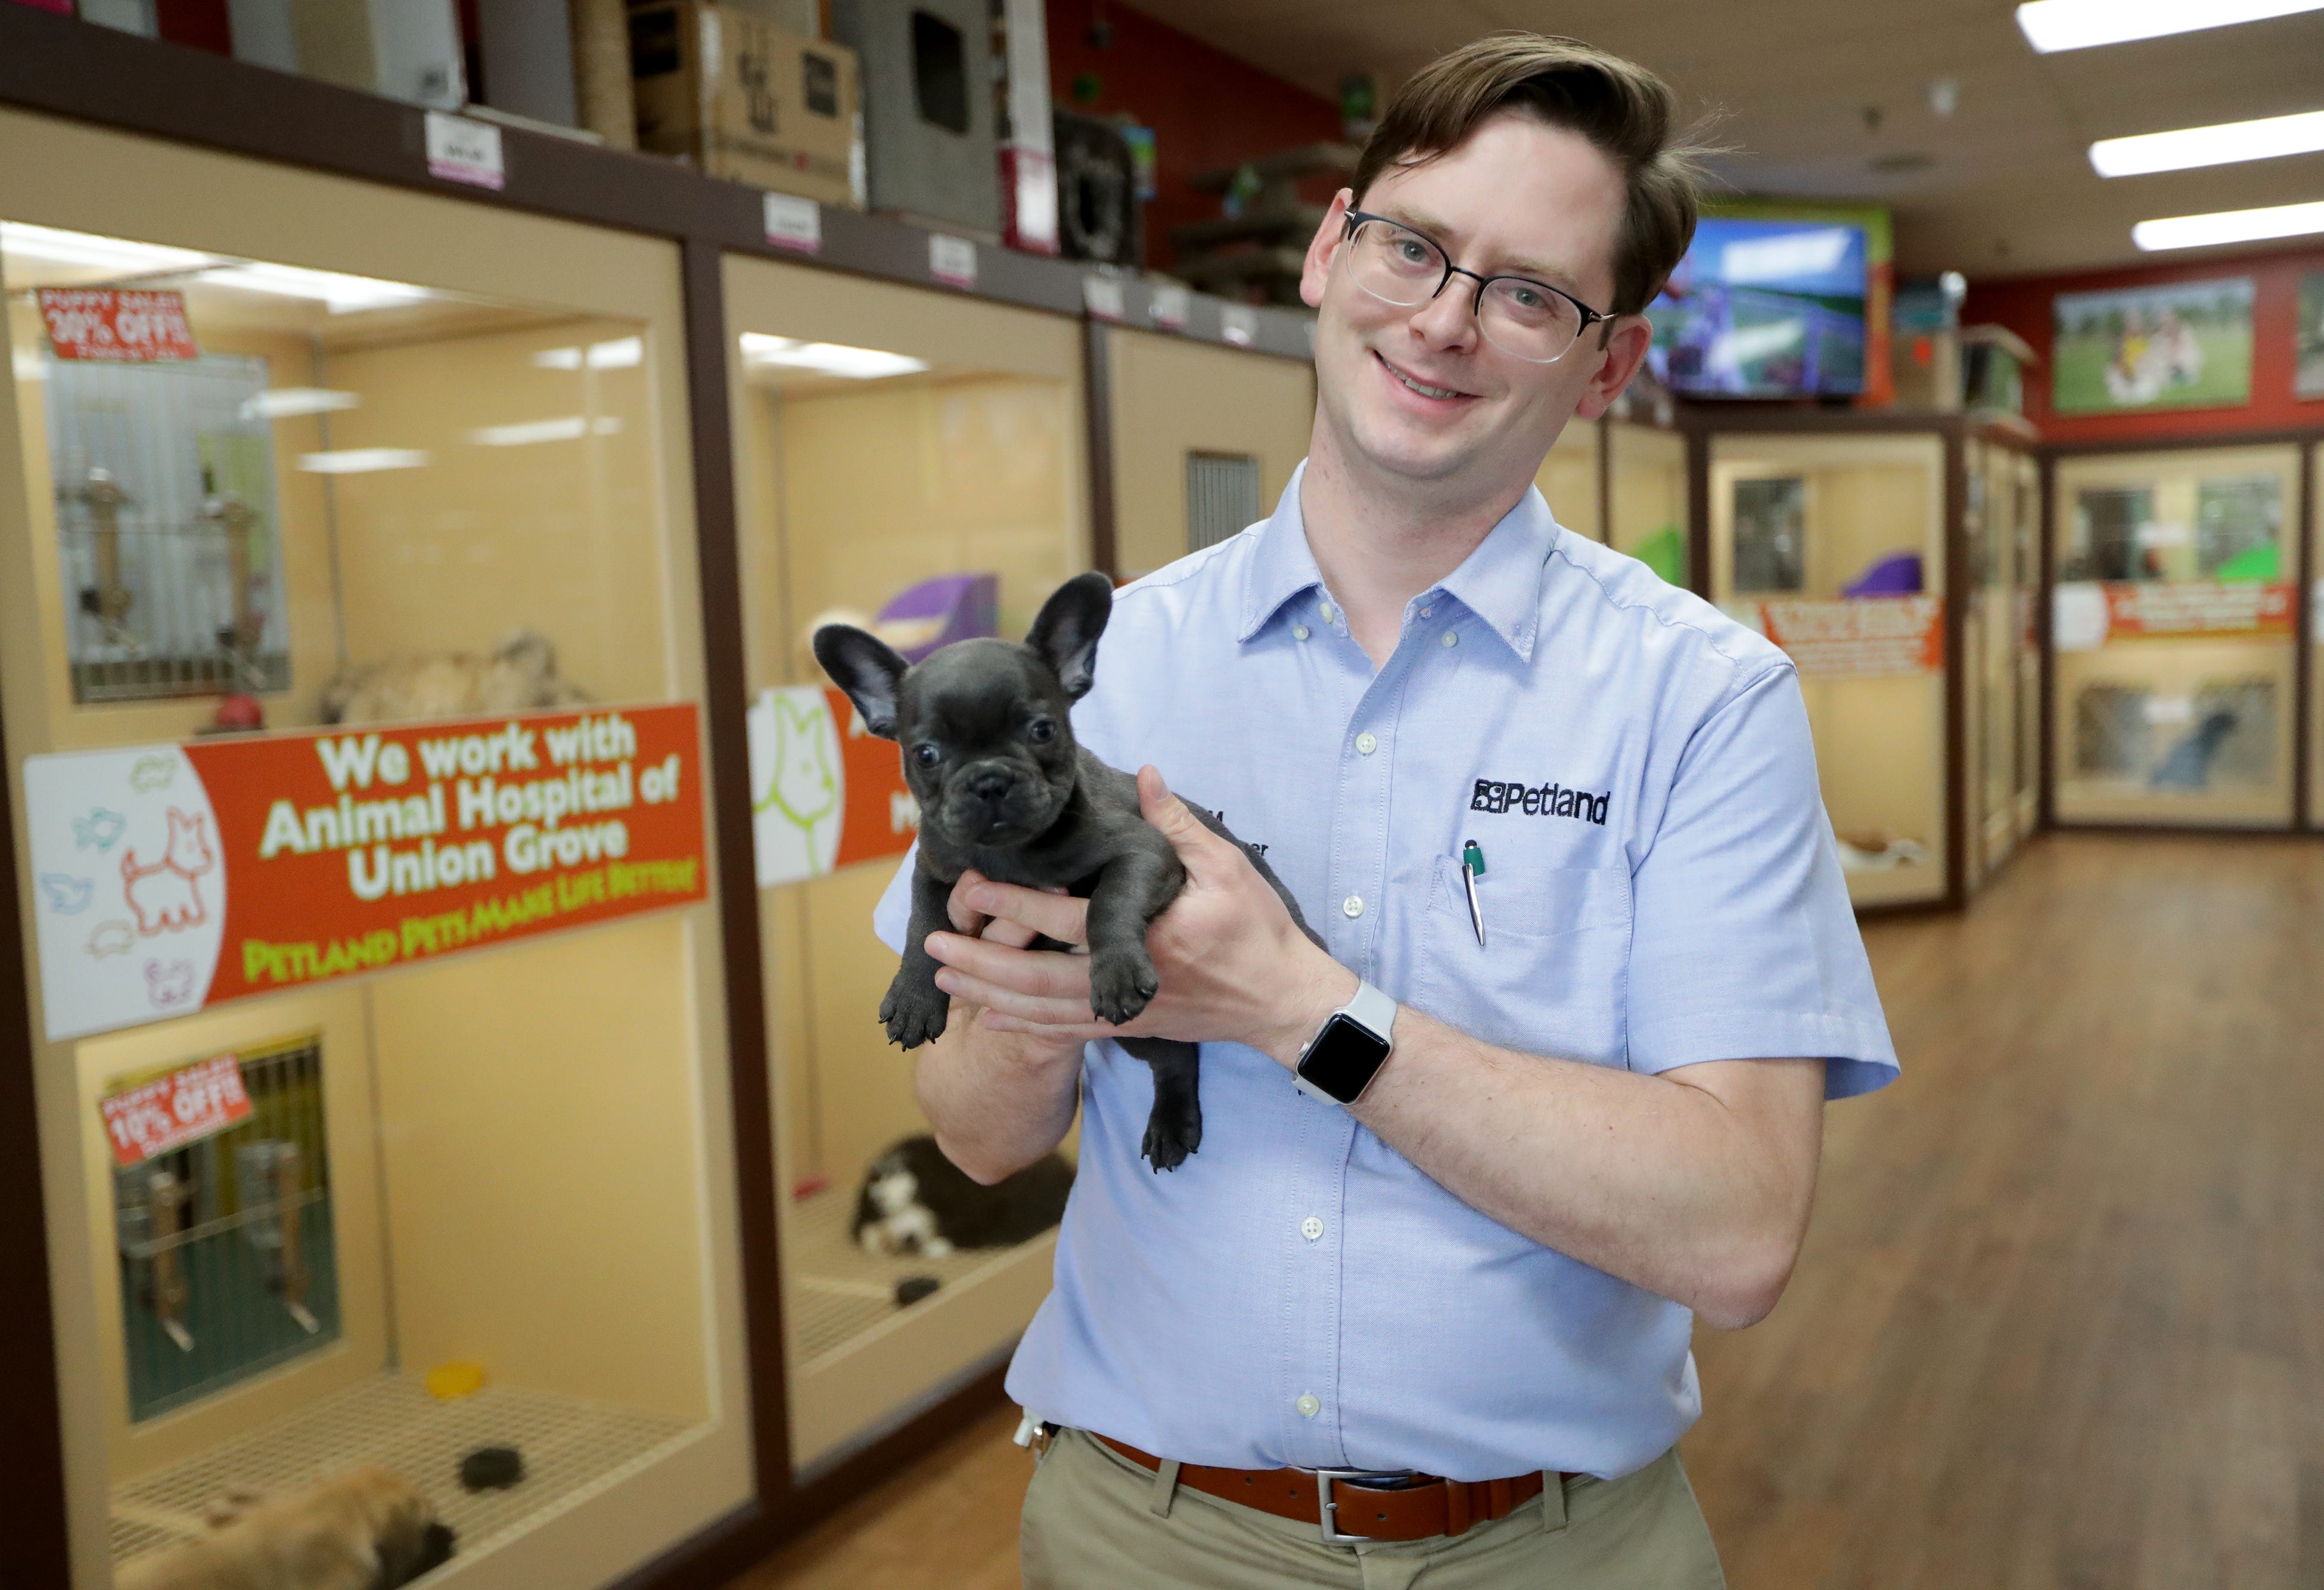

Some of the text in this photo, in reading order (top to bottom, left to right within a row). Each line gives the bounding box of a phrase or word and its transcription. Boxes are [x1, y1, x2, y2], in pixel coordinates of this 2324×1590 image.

[47, 309, 114, 345] 30%
[316, 712, 636, 791] We work with
[258, 753, 681, 858] Animal Hospital of
[1502, 782, 1611, 825] Petland
[347, 820, 628, 900] Union Grove
[242, 930, 398, 983] PETLAND
[400, 908, 467, 957] PETS
[471, 884, 555, 932] MAKE
[558, 872, 605, 911] LIFE
[110, 1103, 172, 1150] 10%
